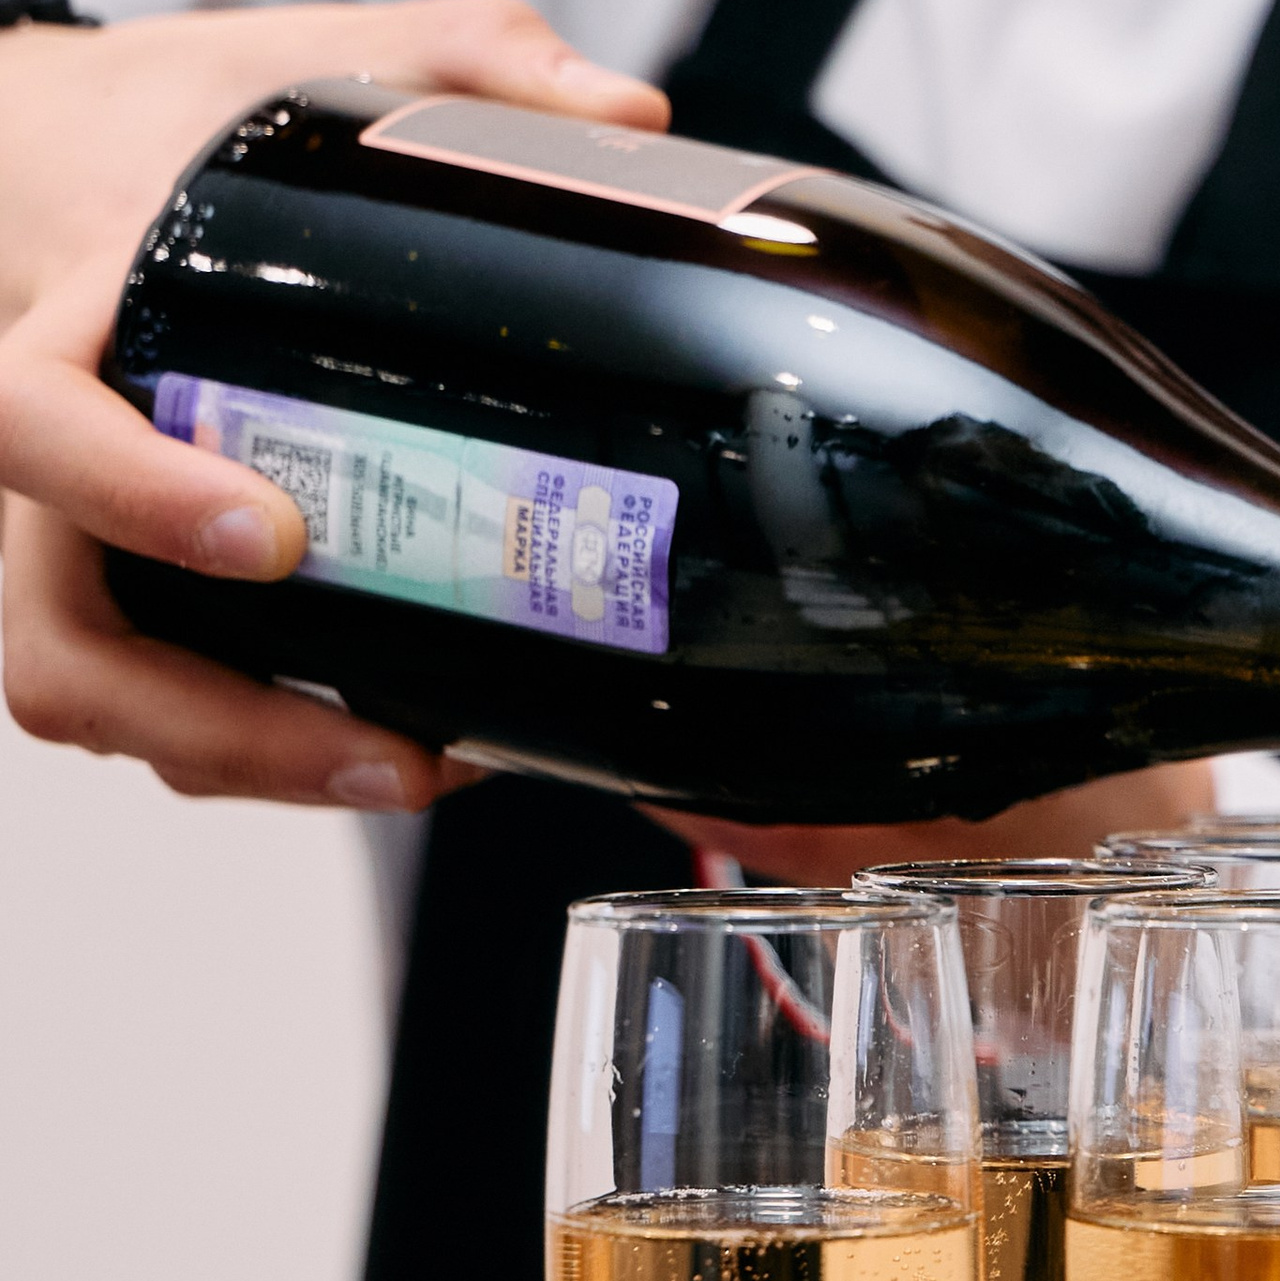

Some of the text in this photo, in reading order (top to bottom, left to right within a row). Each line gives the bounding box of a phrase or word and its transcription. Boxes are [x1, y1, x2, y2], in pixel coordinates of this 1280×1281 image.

[514, 506, 529, 574] МАРКА
[530, 471, 549, 614] СПЕЦИАЛЬНАЯ
[546, 475, 566, 617] ФЕДЕРАЛЬНАЯ
[615, 494, 636, 628] ФЕДЕРАЦИЯ
[631, 496, 653, 631] РОССИЙСКАЯ
